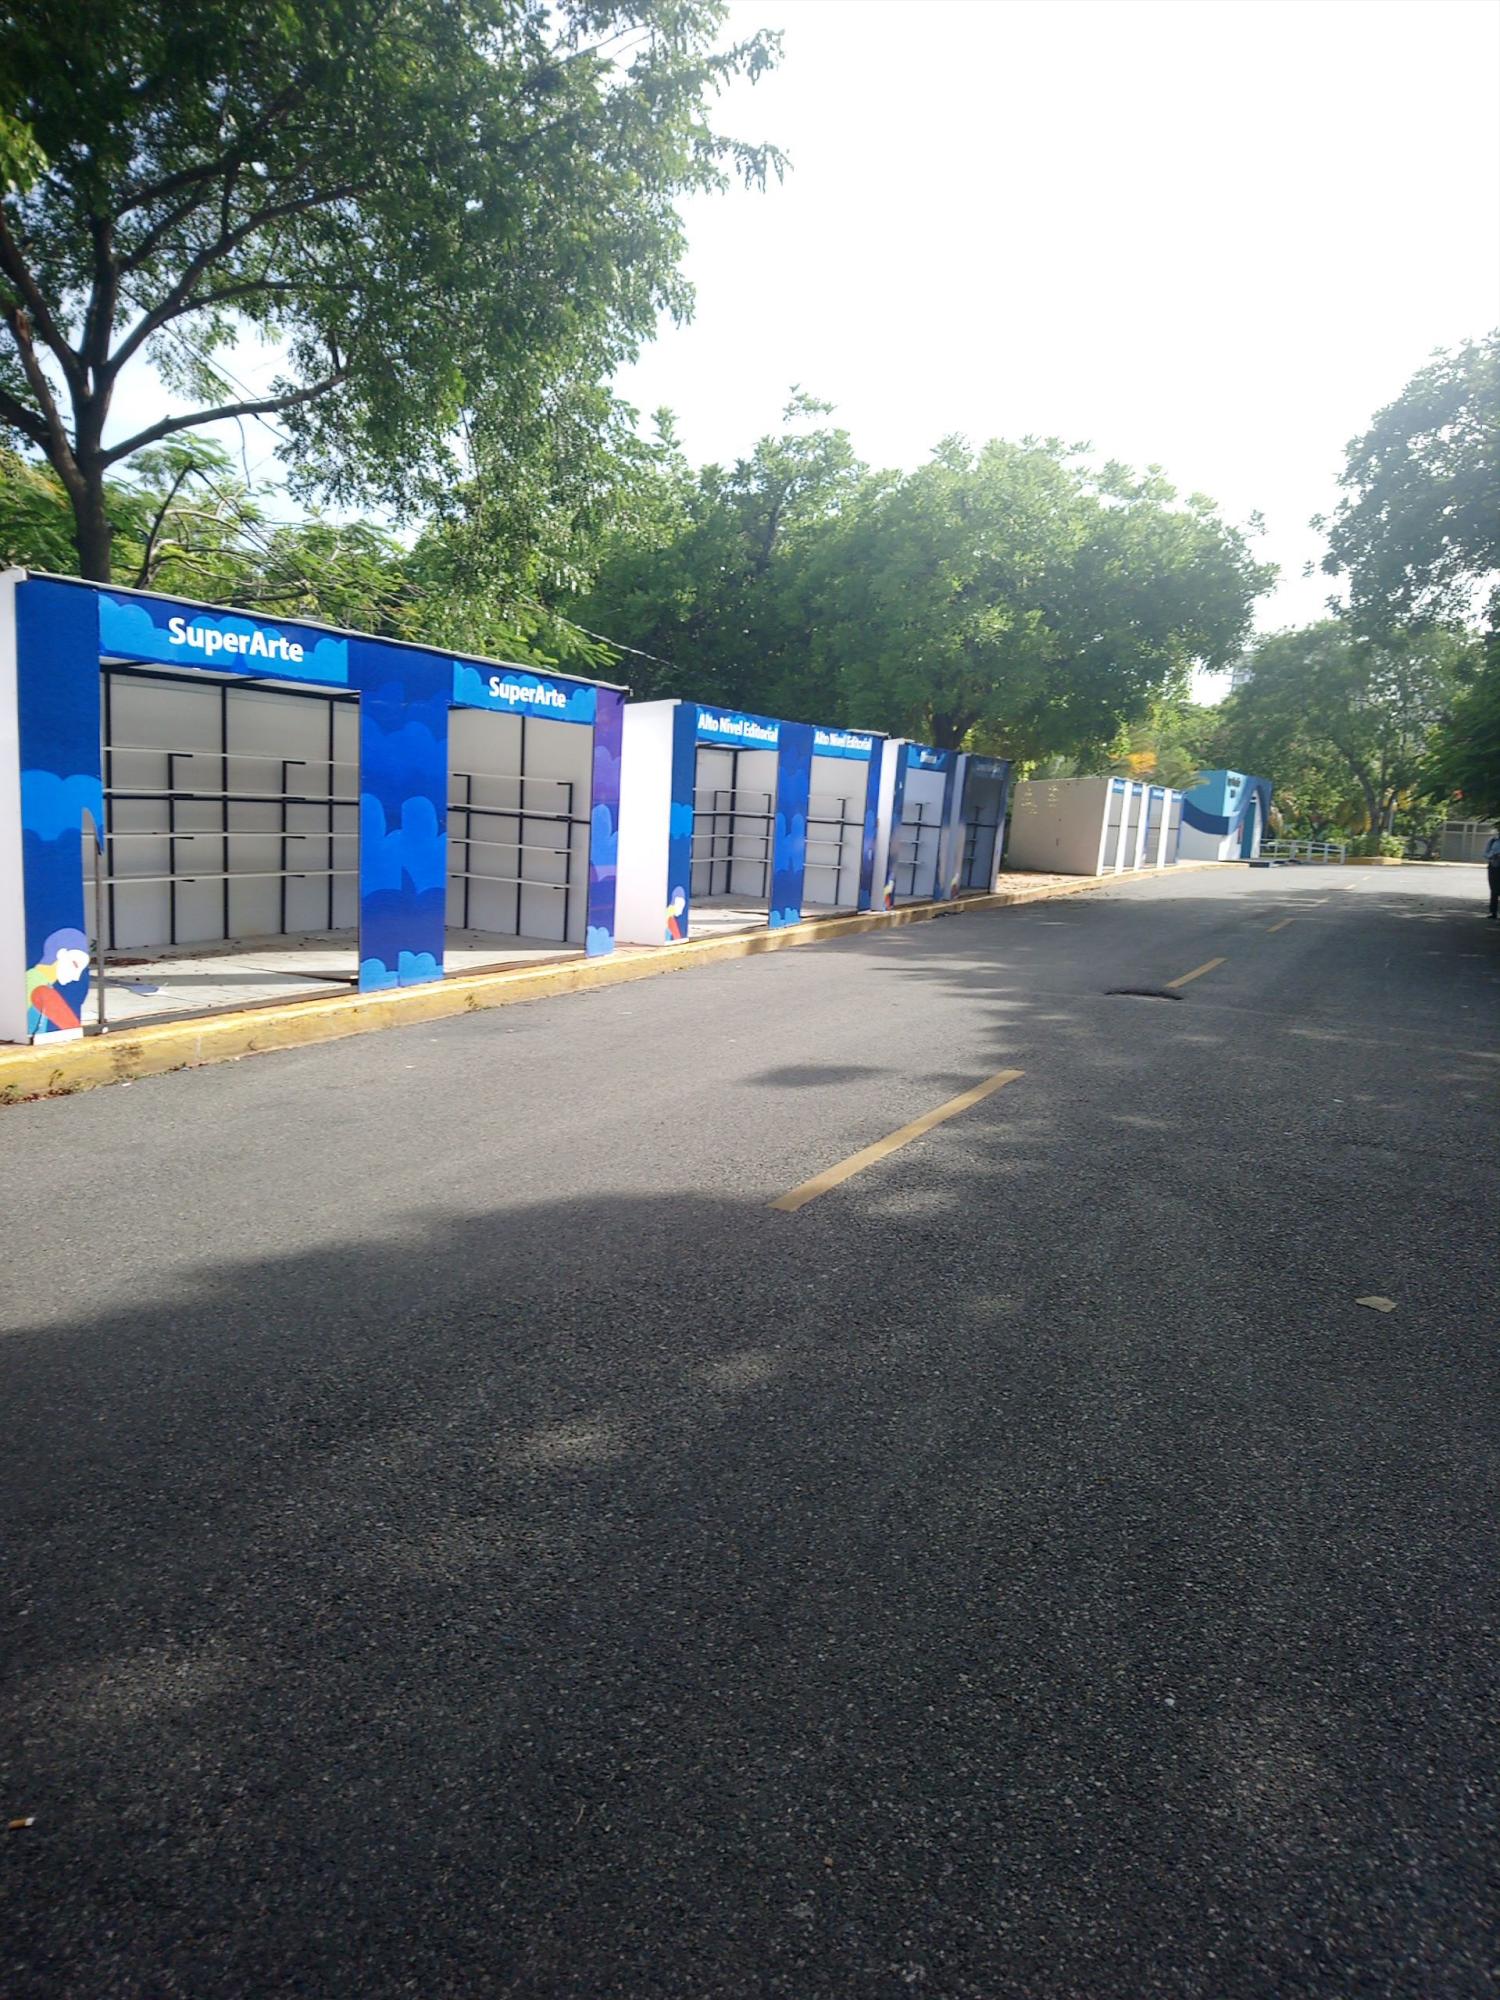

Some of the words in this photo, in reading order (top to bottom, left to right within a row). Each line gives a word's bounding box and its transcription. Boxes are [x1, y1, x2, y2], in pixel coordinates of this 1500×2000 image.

[168, 617, 304, 662] SuperArte
[489, 676, 567, 708] SuperArte
[698, 713, 719, 732] Alto
[719, 717, 743, 736] Nivel
[743, 721, 779, 743] Editorial
